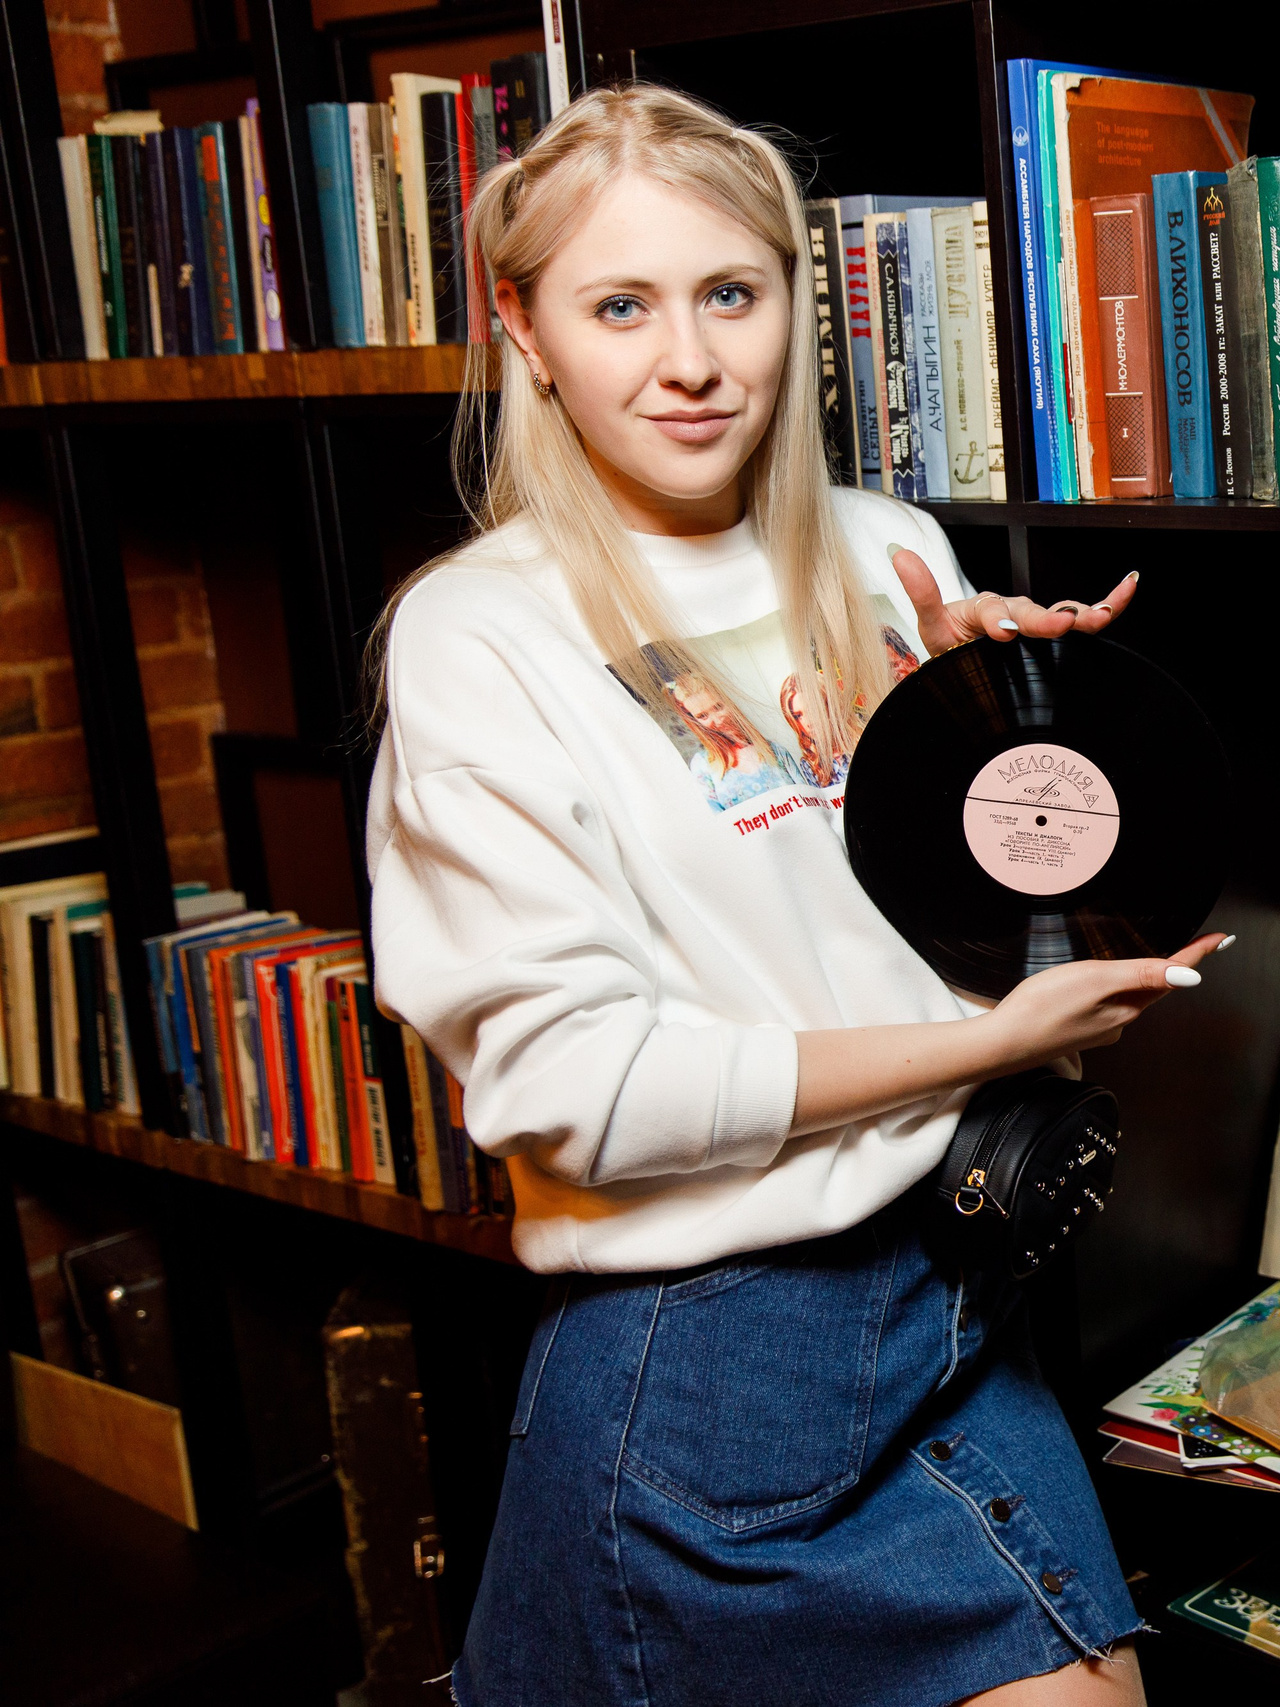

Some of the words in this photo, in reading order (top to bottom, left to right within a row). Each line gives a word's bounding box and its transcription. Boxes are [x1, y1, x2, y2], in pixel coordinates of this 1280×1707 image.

[1019, 158, 1031, 220] АССАМБЛЕЯ
[1023, 221, 1035, 270] НАРОДОВ
[1209, 232, 1222, 280] РАССВЕТ?
[1026, 270, 1040, 337] РЕСПУБЛИКИ
[1167, 209, 1193, 407] В.ЛИХОНОСОВ
[1214, 282, 1223, 301] ИЛИ
[1215, 304, 1225, 335] ЗАКАТ
[1031, 339, 1041, 366] САХА
[1033, 366, 1045, 410] (ЯКУТИЯ)
[1217, 352, 1229, 400] 2000-2008
[858, 380, 870, 460] Константин
[1222, 403, 1231, 436] Россия
[997, 754, 1094, 792] МЕЛОДИЯ
[733, 812, 770, 836] They
[769, 795, 803, 821] don't
[1015, 798, 1052, 806] АПРЕЛЕВСКИЙ
